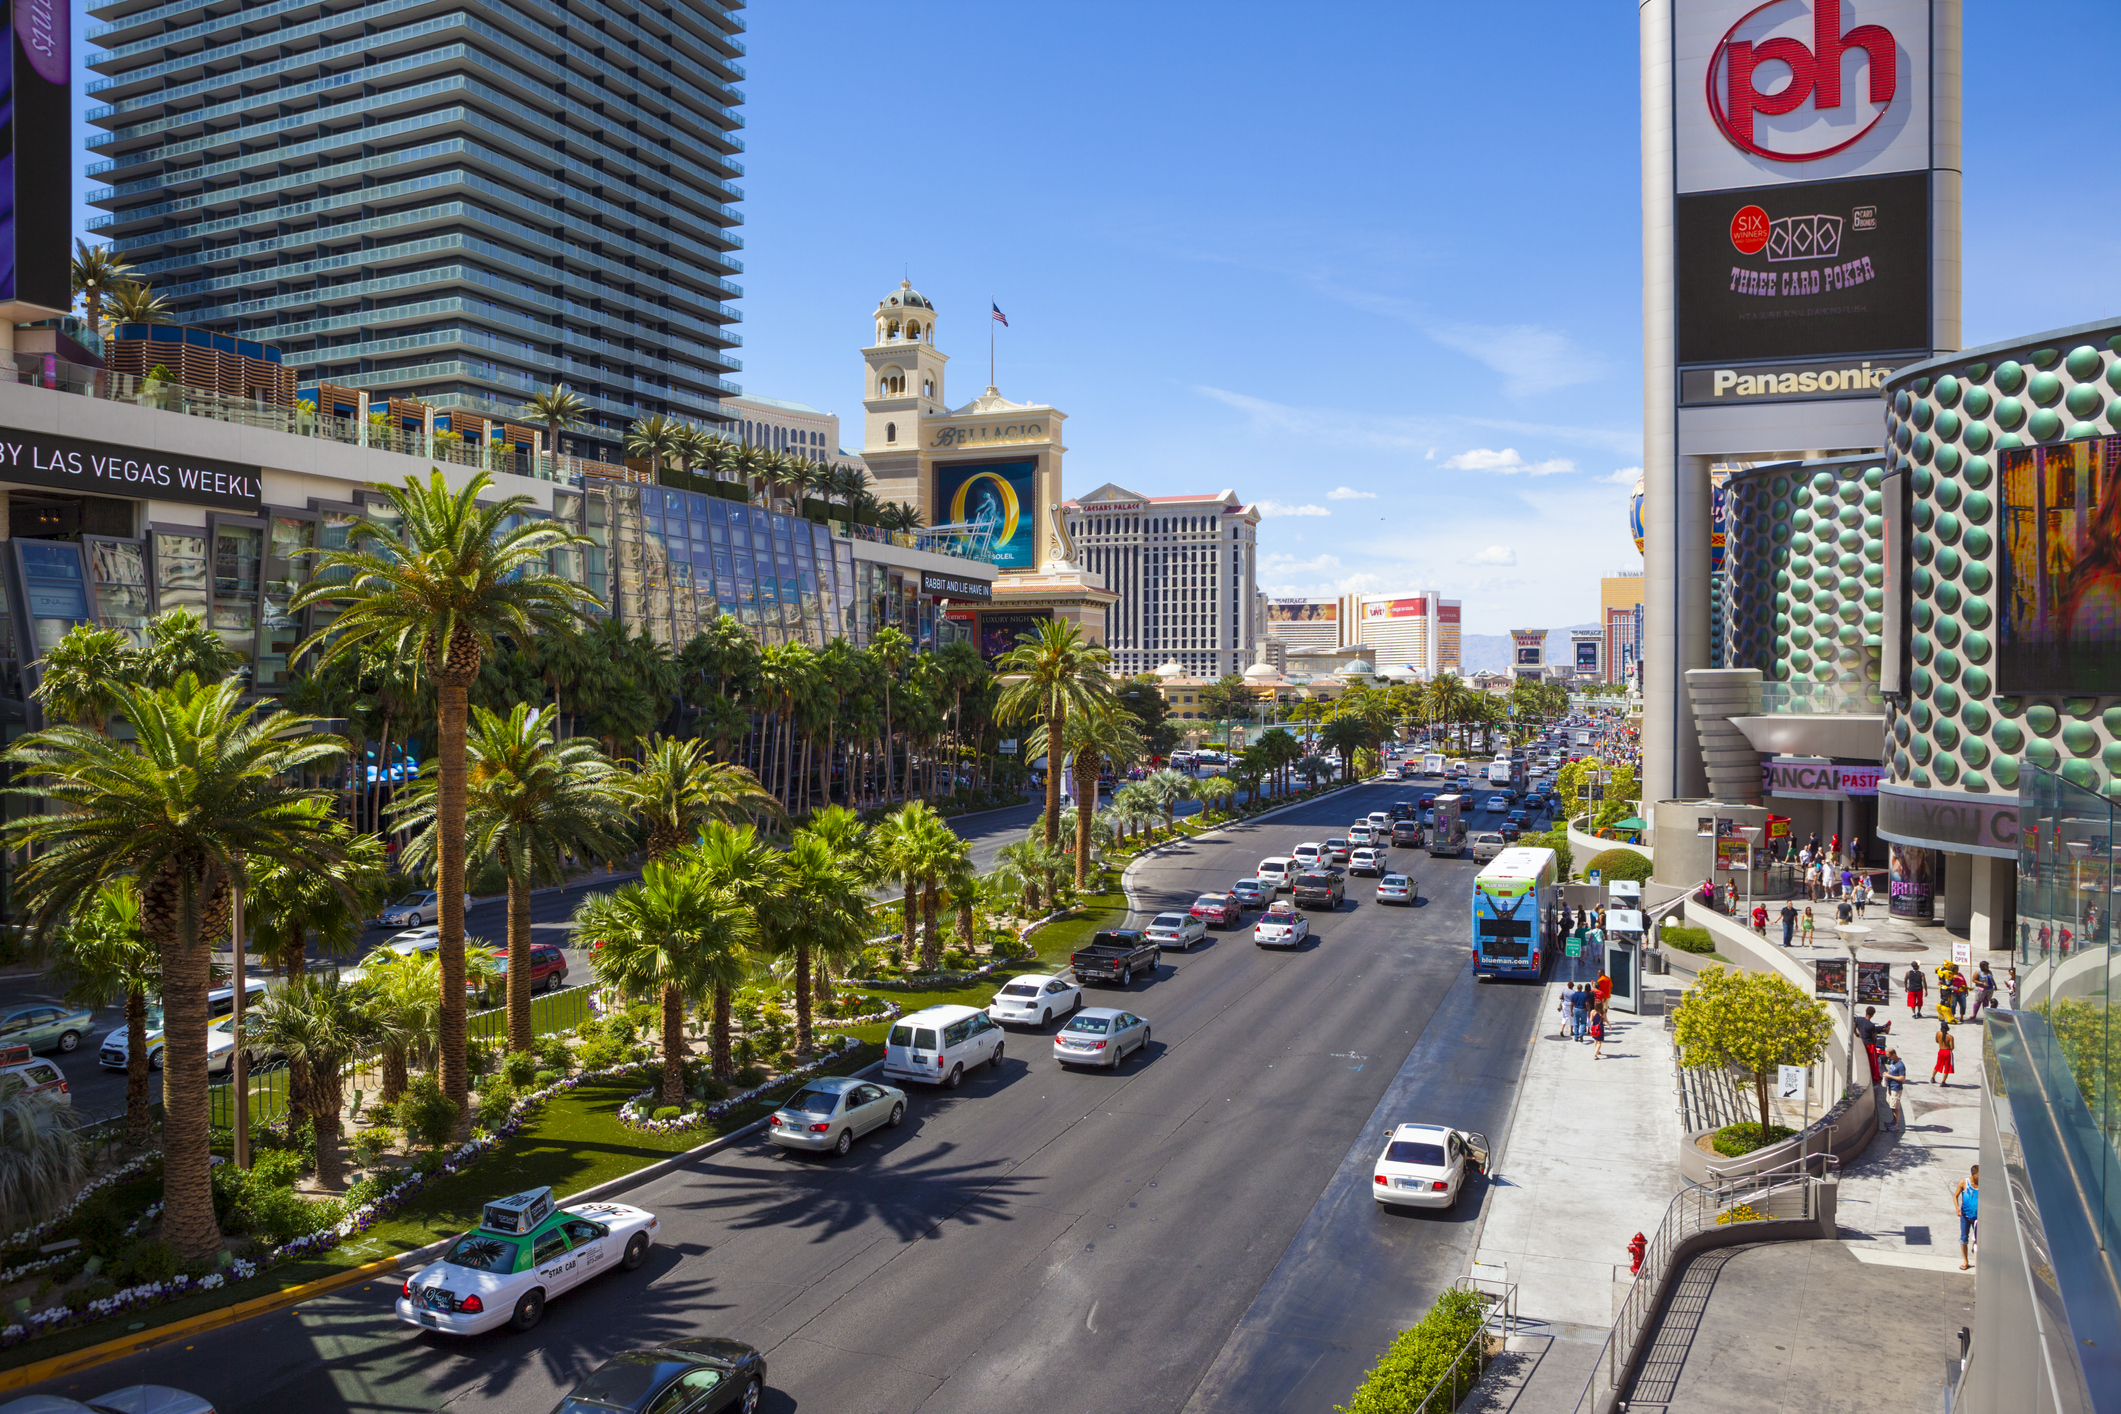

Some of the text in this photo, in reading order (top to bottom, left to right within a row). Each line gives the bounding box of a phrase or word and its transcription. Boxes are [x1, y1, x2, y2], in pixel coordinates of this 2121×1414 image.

[1727, 0, 1896, 143] ph
[1738, 215, 1762, 231] SIX
[1854, 211, 1861, 228] 6
[1734, 229, 1768, 239] WINNERS
[1730, 256, 1875, 297] THREE CARD POKER
[1714, 361, 1892, 397] Panasonic
[930, 423, 1042, 448] BELLAGIO
[33, 446, 83, 475] LAS
[91, 455, 171, 487] VEGAS
[1113, 503, 1140, 511] PALACE
[925, 576, 946, 590] RABBIT
[946, 581, 958, 592] AND
[959, 582, 968, 593] LIE
[968, 583, 983, 596] HAVE
[982, 586, 989, 596] IN
[982, 615, 1009, 624] LUXURY
[1921, 803, 1982, 845] YOU
[1990, 810, 2019, 844] C
[1891, 880, 1934, 897] BRITNEY
[1481, 957, 1529, 965] blueman.com
[1955, 956, 1968, 964] OPEN
[548, 1259, 577, 1279] STAR CAB
